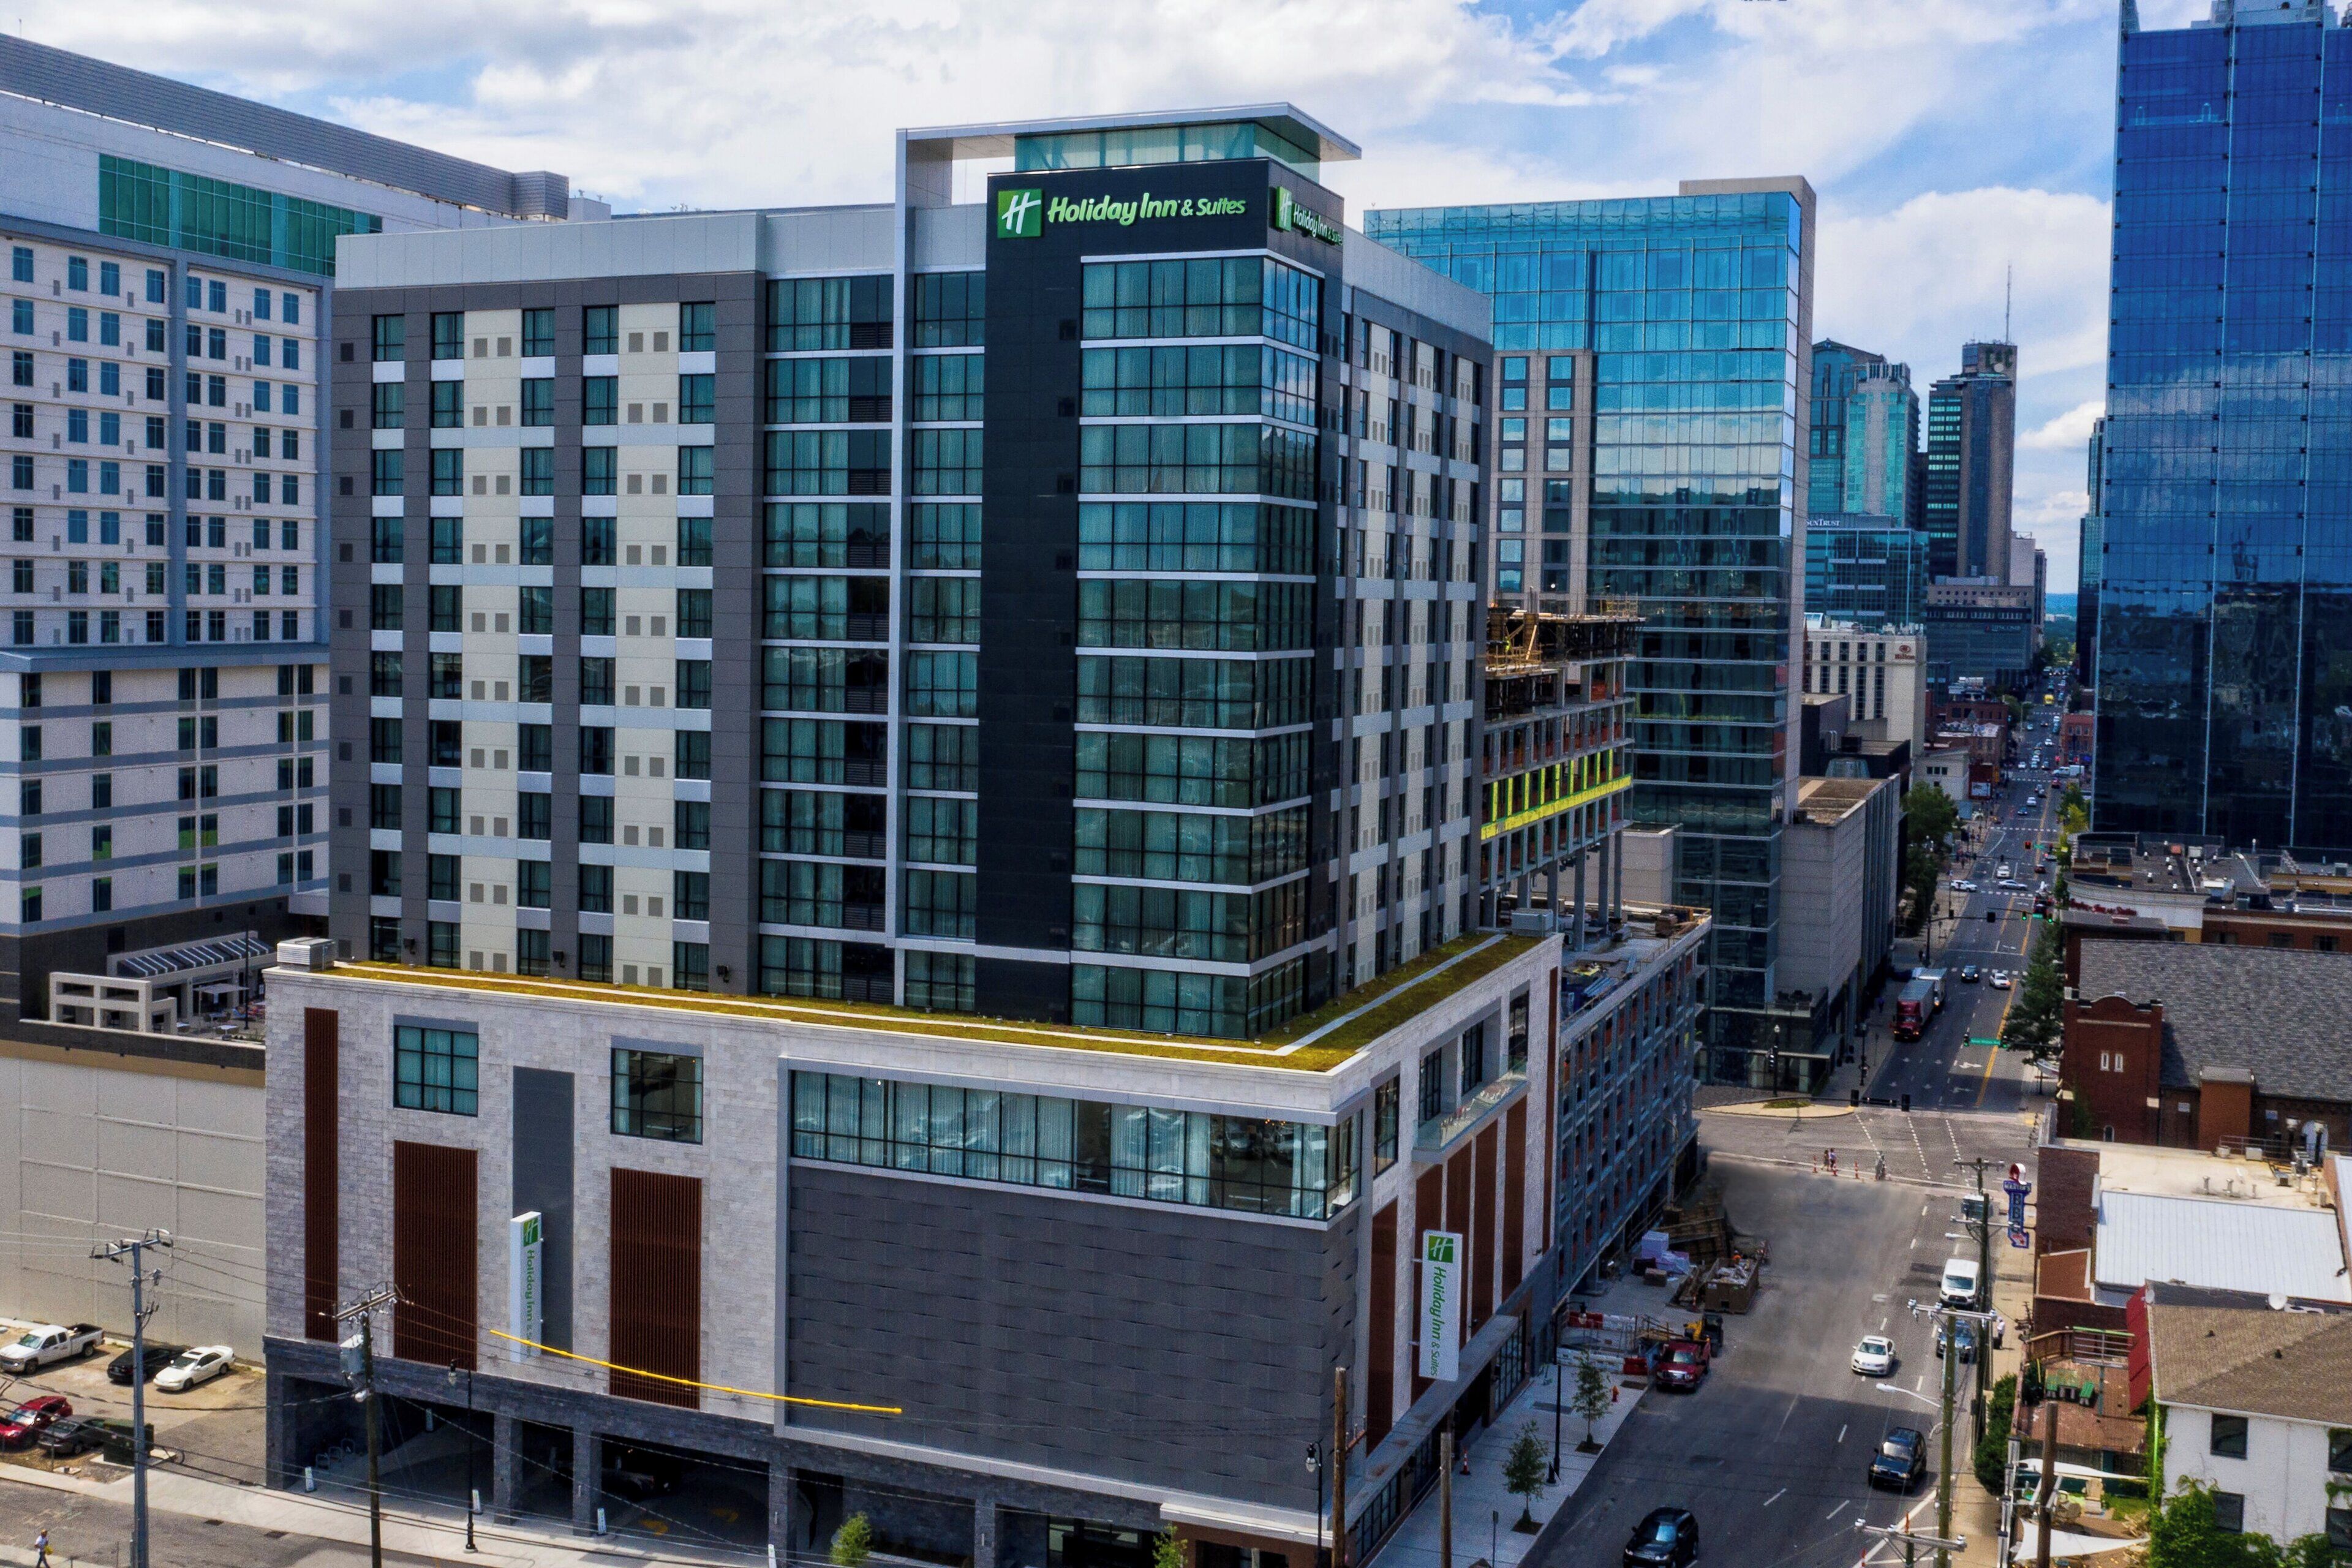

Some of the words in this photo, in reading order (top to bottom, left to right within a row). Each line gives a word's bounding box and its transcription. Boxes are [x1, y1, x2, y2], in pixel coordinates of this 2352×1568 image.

[1047, 195, 1137, 225] Holiday
[1140, 192, 1177, 219] Inn
[1181, 199, 1193, 216] &
[1196, 197, 1246, 216] Suites
[1293, 203, 1318, 238] Holiday
[1318, 215, 1328, 238] Inn
[525, 1250, 535, 1301] Holiday
[1430, 1266, 1447, 1318] Holiday
[1432, 1318, 1445, 1340] Inn
[1430, 1350, 1439, 1376] Suites
